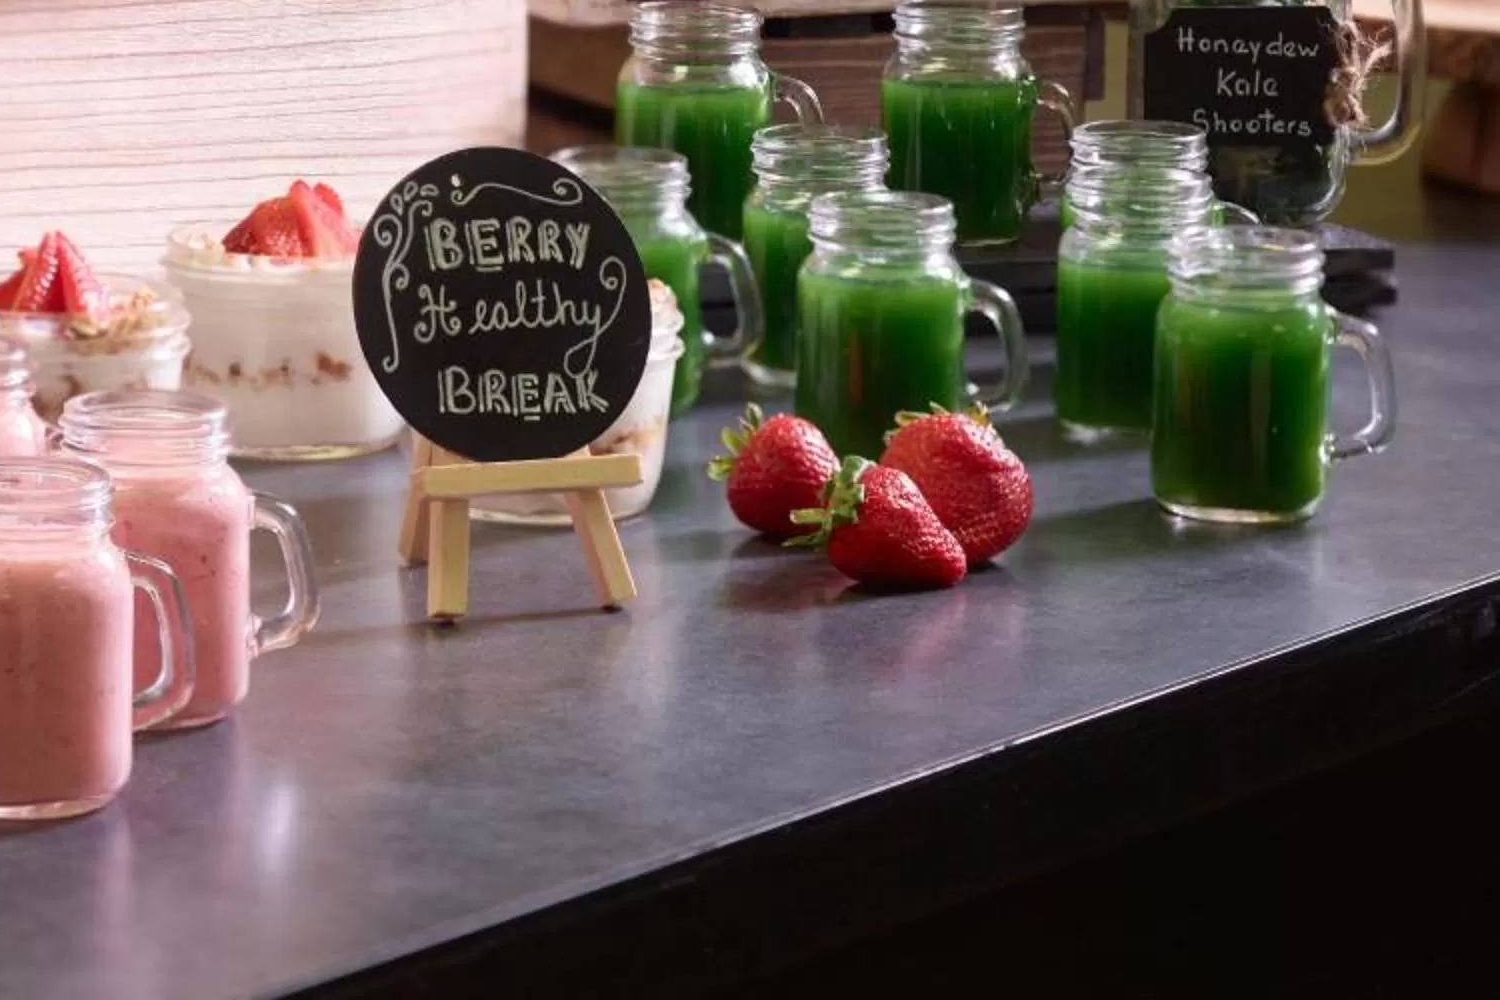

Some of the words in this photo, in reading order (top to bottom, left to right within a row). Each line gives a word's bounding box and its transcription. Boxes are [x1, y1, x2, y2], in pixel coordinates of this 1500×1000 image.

[1176, 25, 1321, 64] Honeydew
[1216, 67, 1279, 98] Kale
[1192, 107, 1313, 137] Shooters
[424, 215, 590, 272] BERRY
[437, 365, 610, 421] BREAK
